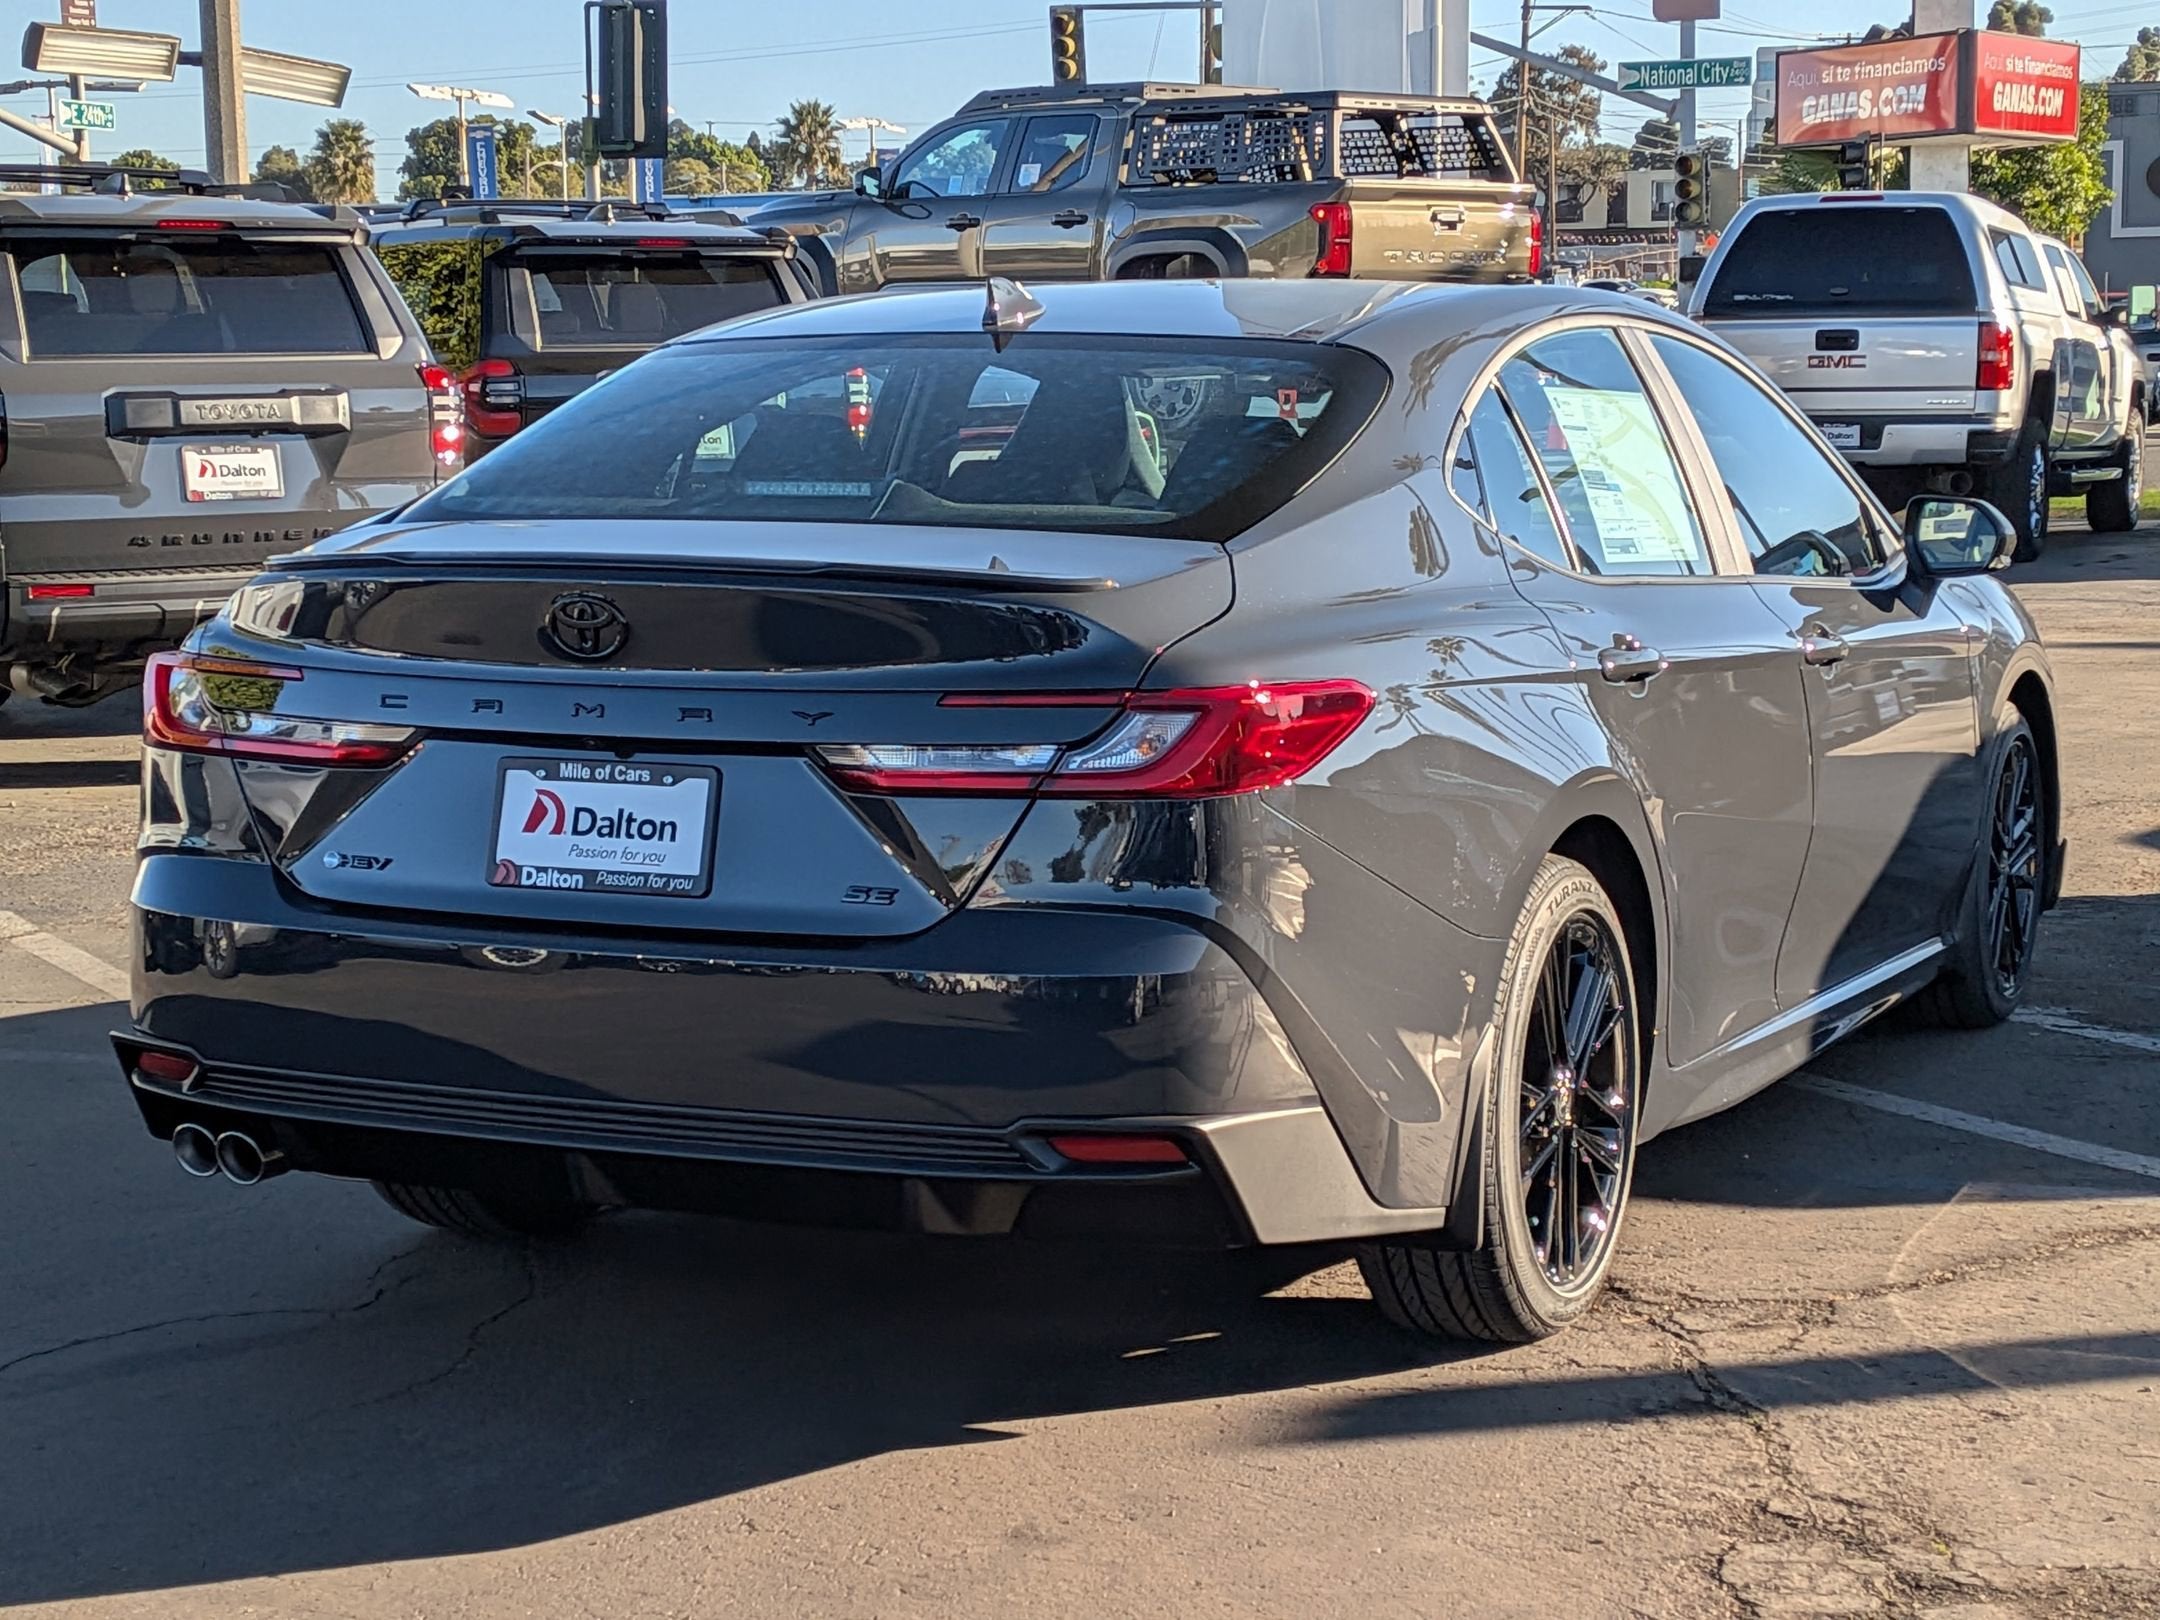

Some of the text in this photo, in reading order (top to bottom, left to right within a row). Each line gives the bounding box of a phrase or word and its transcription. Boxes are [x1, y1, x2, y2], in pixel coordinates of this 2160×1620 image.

[1640, 61, 1730, 87] National City
[1822, 65, 1834, 84] sí
[1836, 65, 1851, 82] te
[1854, 56, 1946, 80] financiamos
[2025, 56, 2074, 80] financiamos
[1803, 83, 1928, 124] GANAS.COM
[1993, 81, 2065, 118] GANAS.COM
[71, 103, 81, 125] E
[81, 104, 105, 126] 24th
[1383, 249, 1507, 265] TACOMA
[1808, 355, 1867, 369] GMC
[195, 403, 282, 420] TOYOTA
[219, 465, 266, 477] Dalton
[380, 693, 836, 727] CAMRY
[559, 763, 651, 782] Mile of Cars
[571, 806, 677, 843] Dalton
[568, 844, 667, 865] Passion for you
[521, 866, 694, 892] Dalton Passion for you
[840, 885, 900, 906] SE
